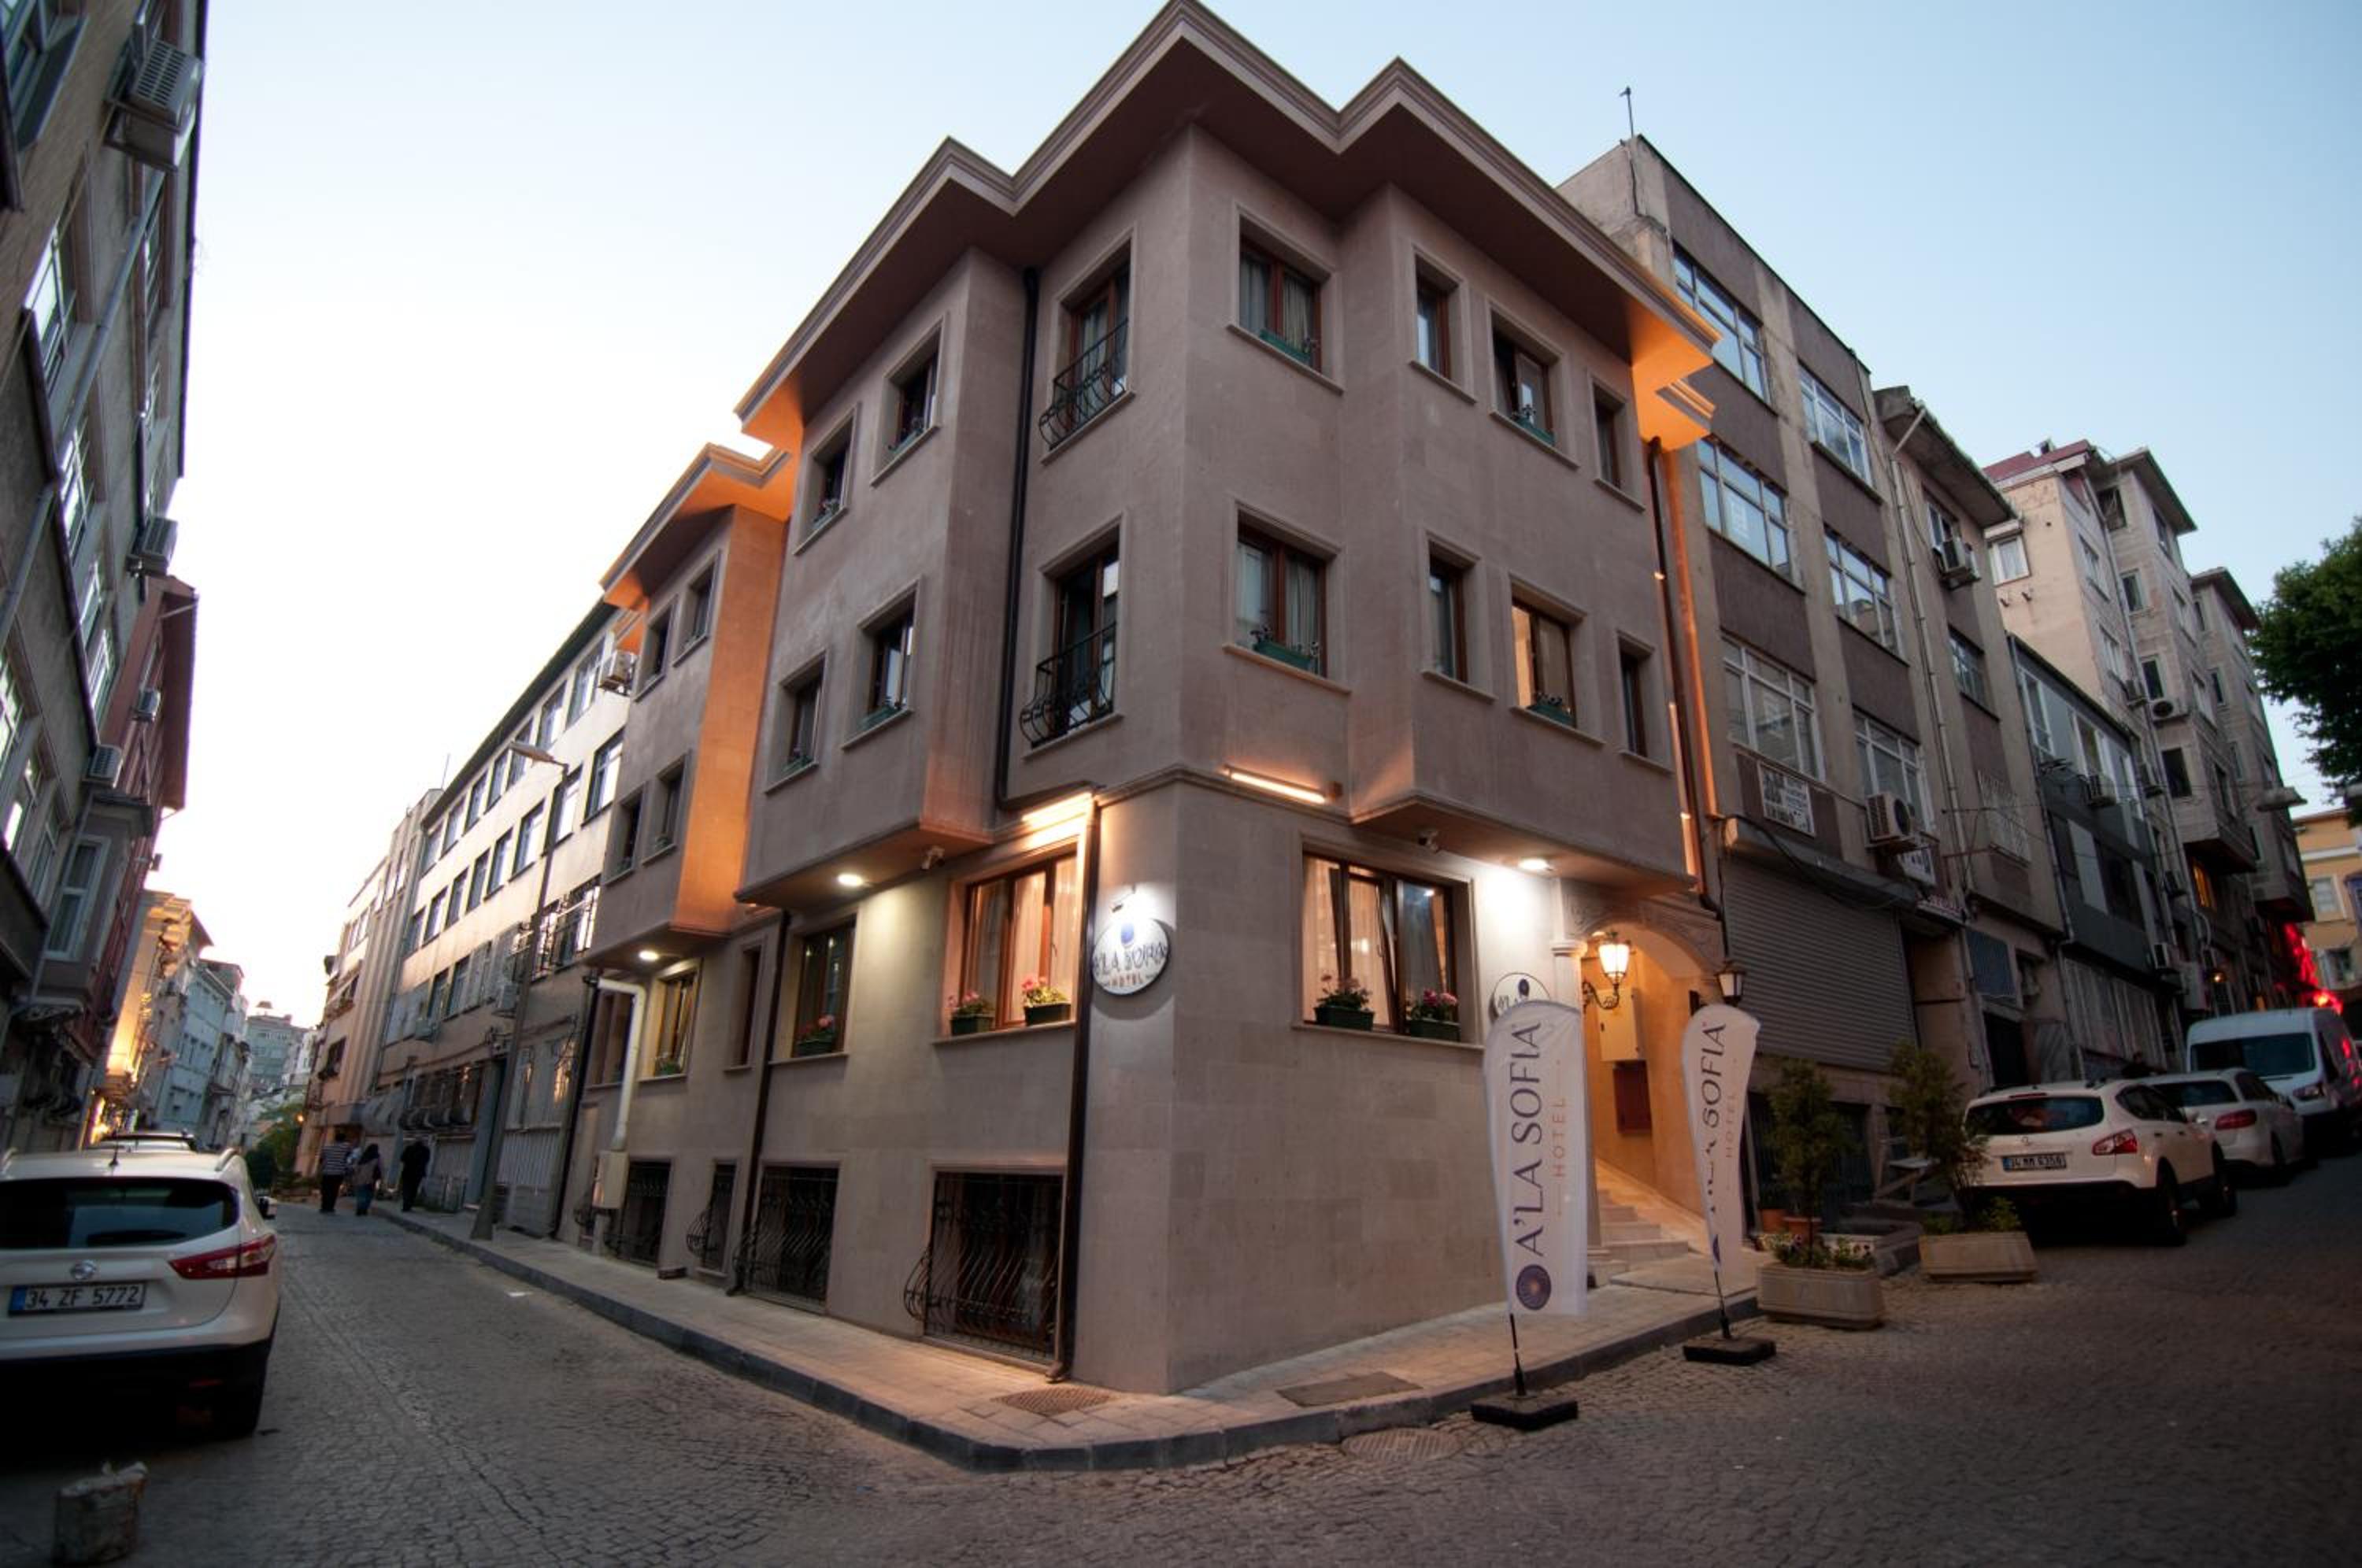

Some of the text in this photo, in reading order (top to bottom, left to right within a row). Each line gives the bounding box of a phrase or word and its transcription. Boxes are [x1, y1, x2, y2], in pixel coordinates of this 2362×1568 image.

[1701, 1023, 1726, 1128] SOFIA
[1509, 1023, 1544, 1256] A'LA SOFIA
[1552, 1098, 1566, 1177] HOTEL
[1725, 1095, 1736, 1158] HOTEL
[27, 1286, 139, 1308] 34 ZF 5772
